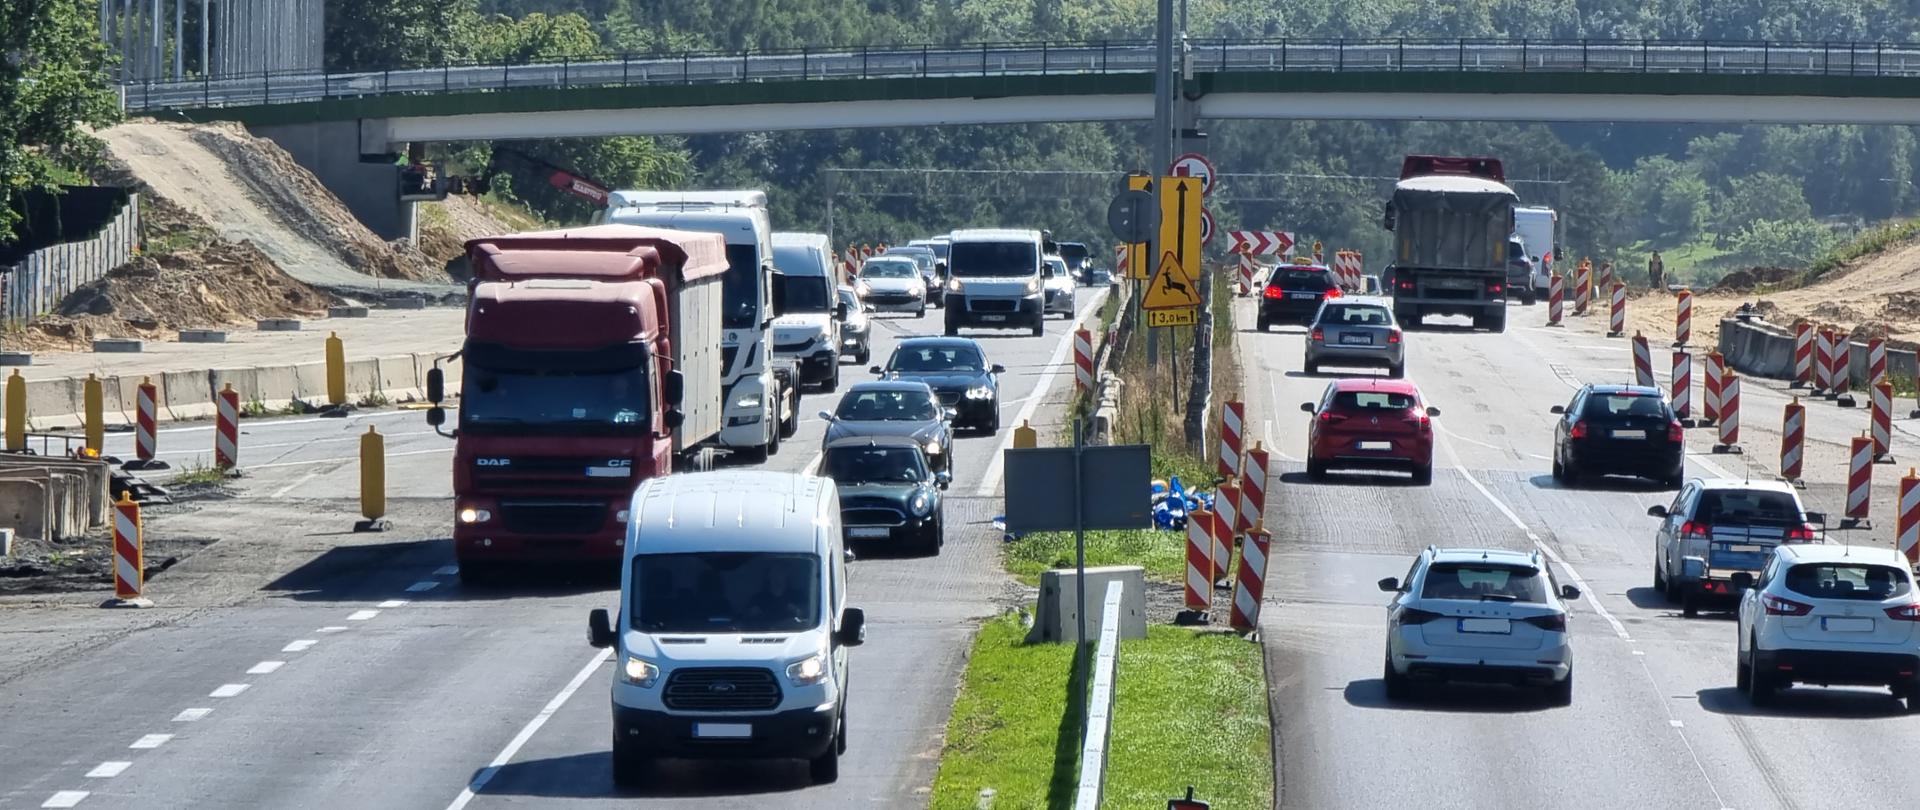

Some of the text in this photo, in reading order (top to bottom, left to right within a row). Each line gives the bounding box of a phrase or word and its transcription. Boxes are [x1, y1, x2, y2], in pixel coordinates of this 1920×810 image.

[1176, 314, 1188, 322] km
[476, 458, 511, 466] DAF
[607, 459, 632, 467] CF
